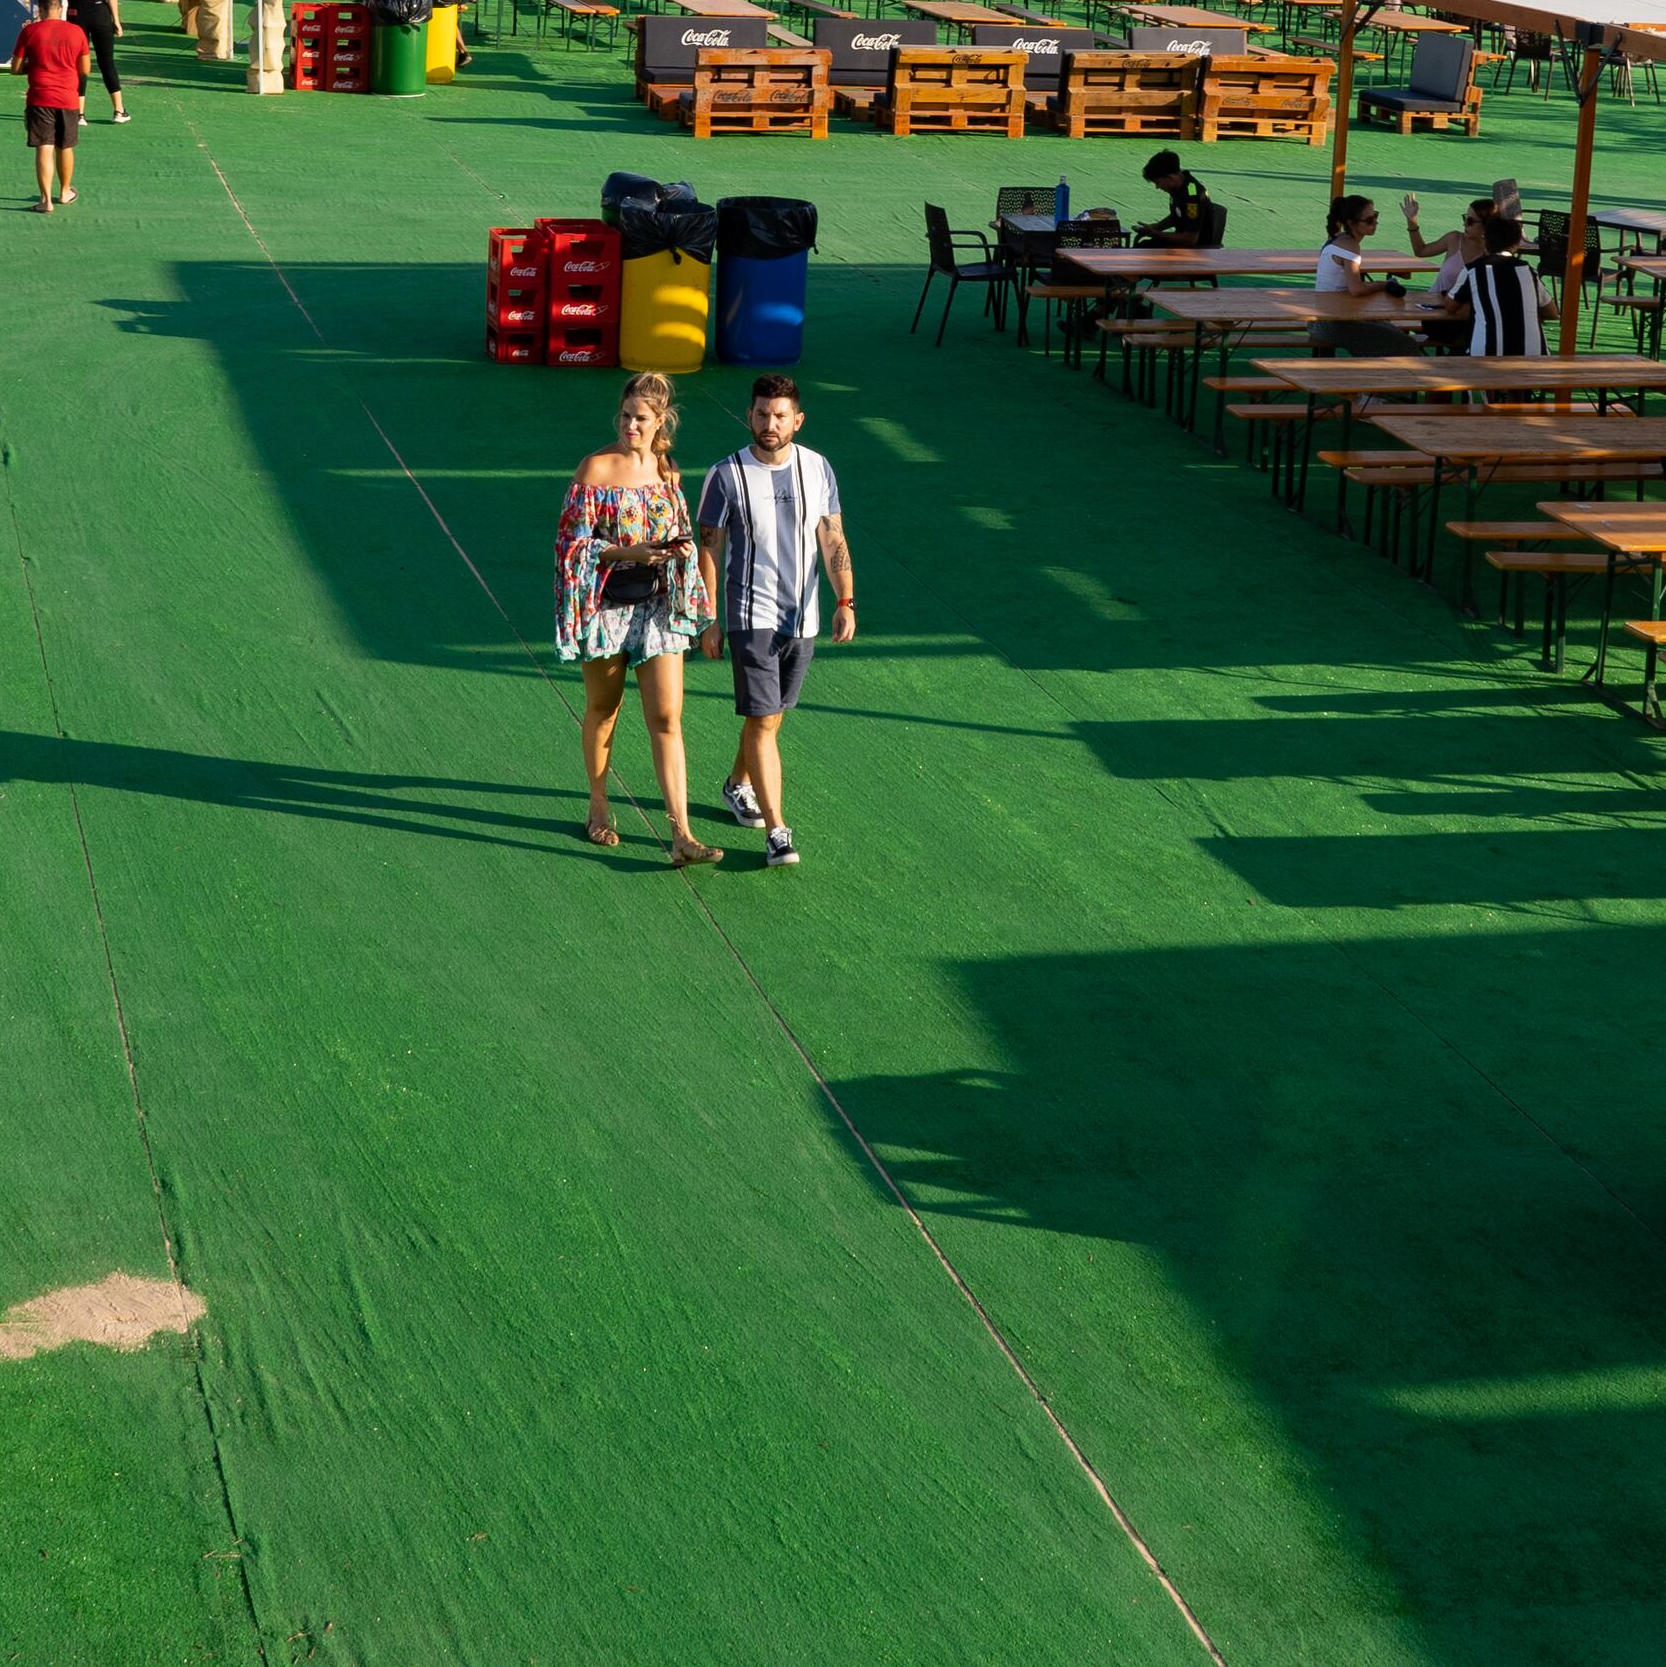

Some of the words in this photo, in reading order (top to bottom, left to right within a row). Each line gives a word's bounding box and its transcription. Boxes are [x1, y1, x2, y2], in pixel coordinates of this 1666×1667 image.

[681, 29, 732, 47] Coca-Cola
[1013, 37, 1061, 55] Coca-Cola
[1167, 40, 1213, 56] Coca-Cola
[510, 267, 537, 277] Coca-Cola
[564, 261, 595, 272] Coca-Cola
[561, 304, 595, 315] Coca-Cola
[559, 351, 592, 362] Coca-Cola
